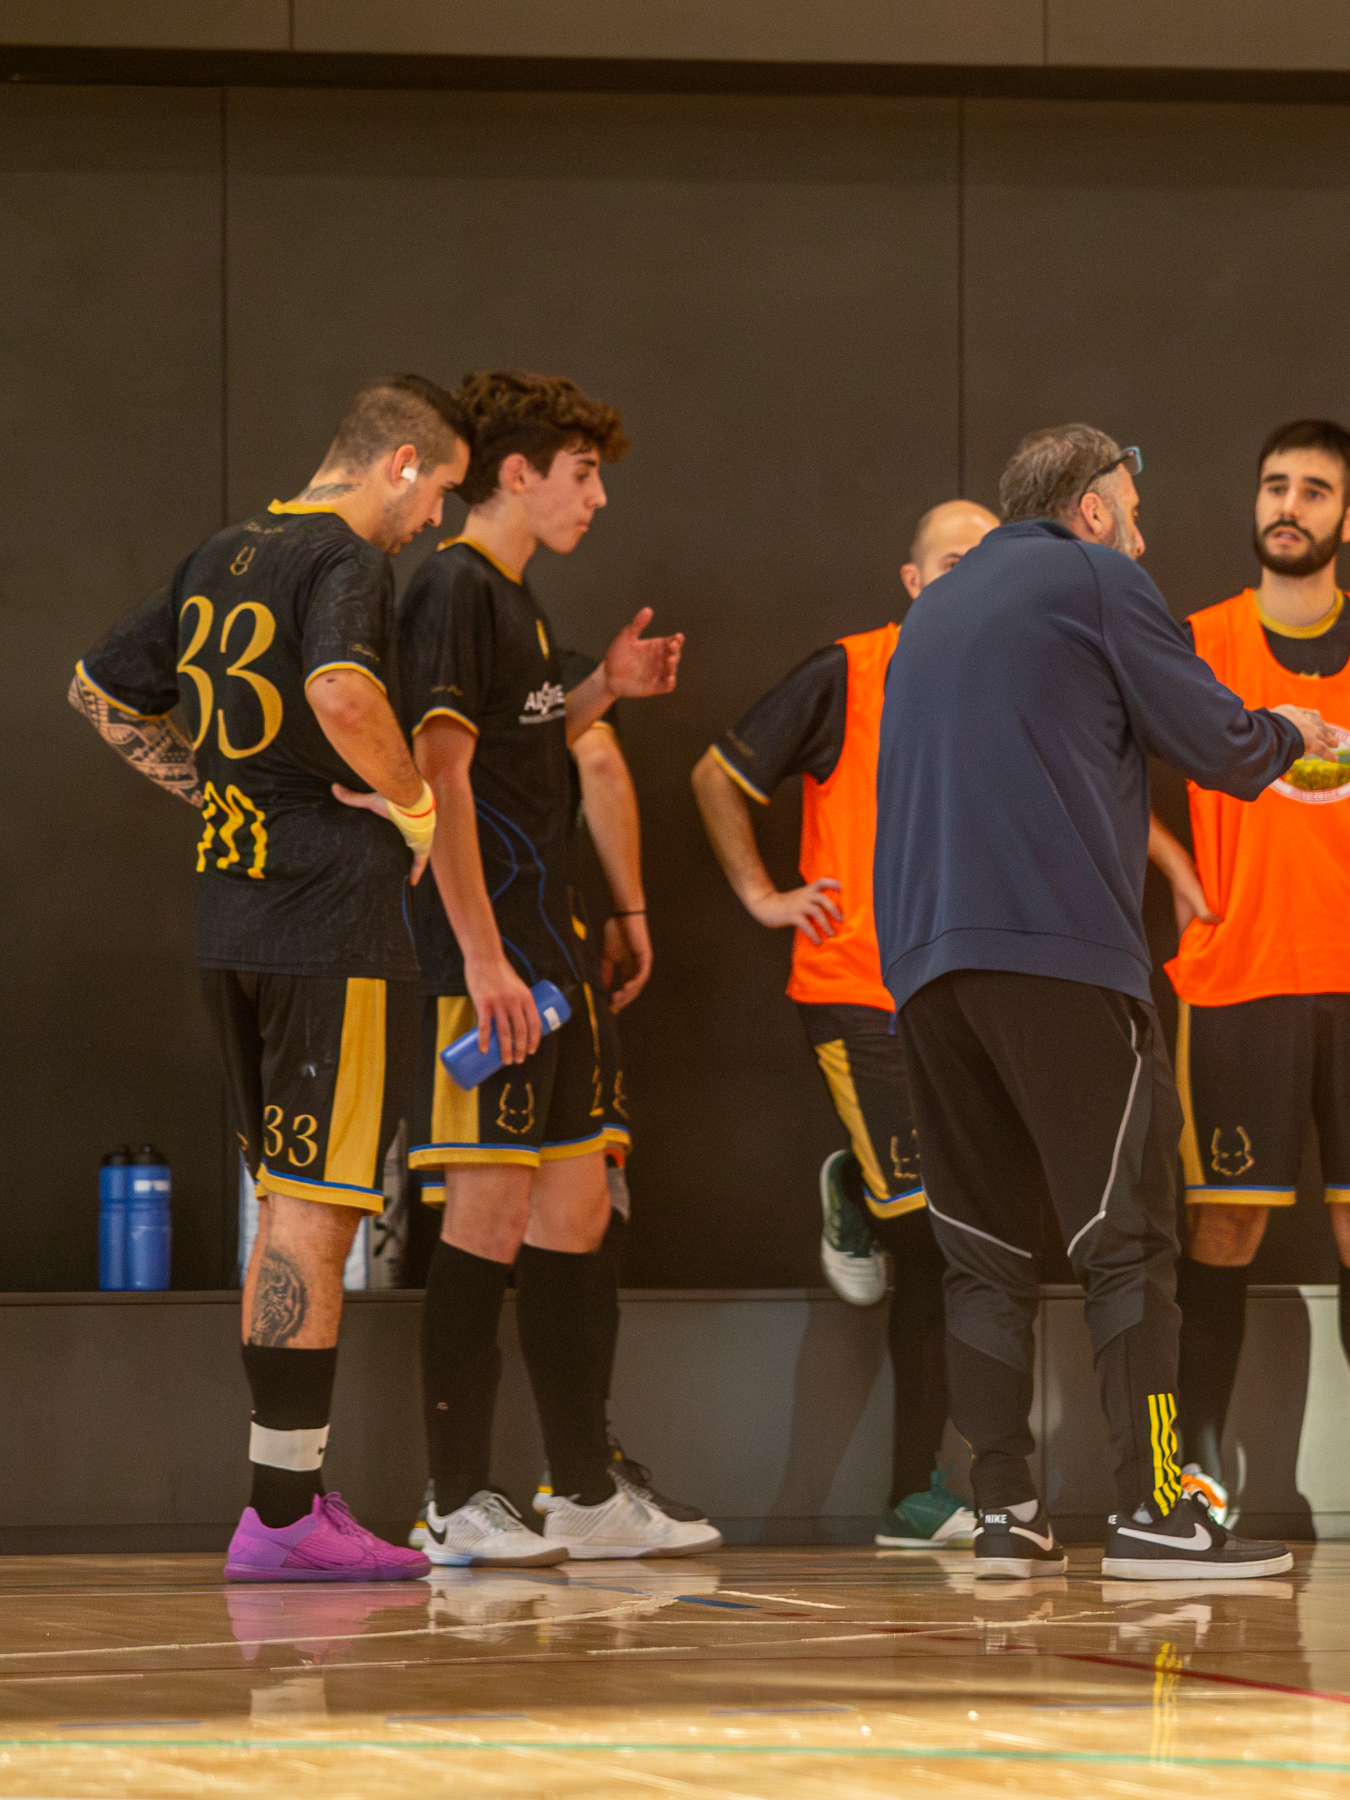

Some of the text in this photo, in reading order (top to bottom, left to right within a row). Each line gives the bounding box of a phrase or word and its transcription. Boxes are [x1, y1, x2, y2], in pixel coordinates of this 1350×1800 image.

[176, 594, 284, 760] 33
[263, 1104, 319, 1168] 33
[984, 1513, 1008, 1525] NIKE
